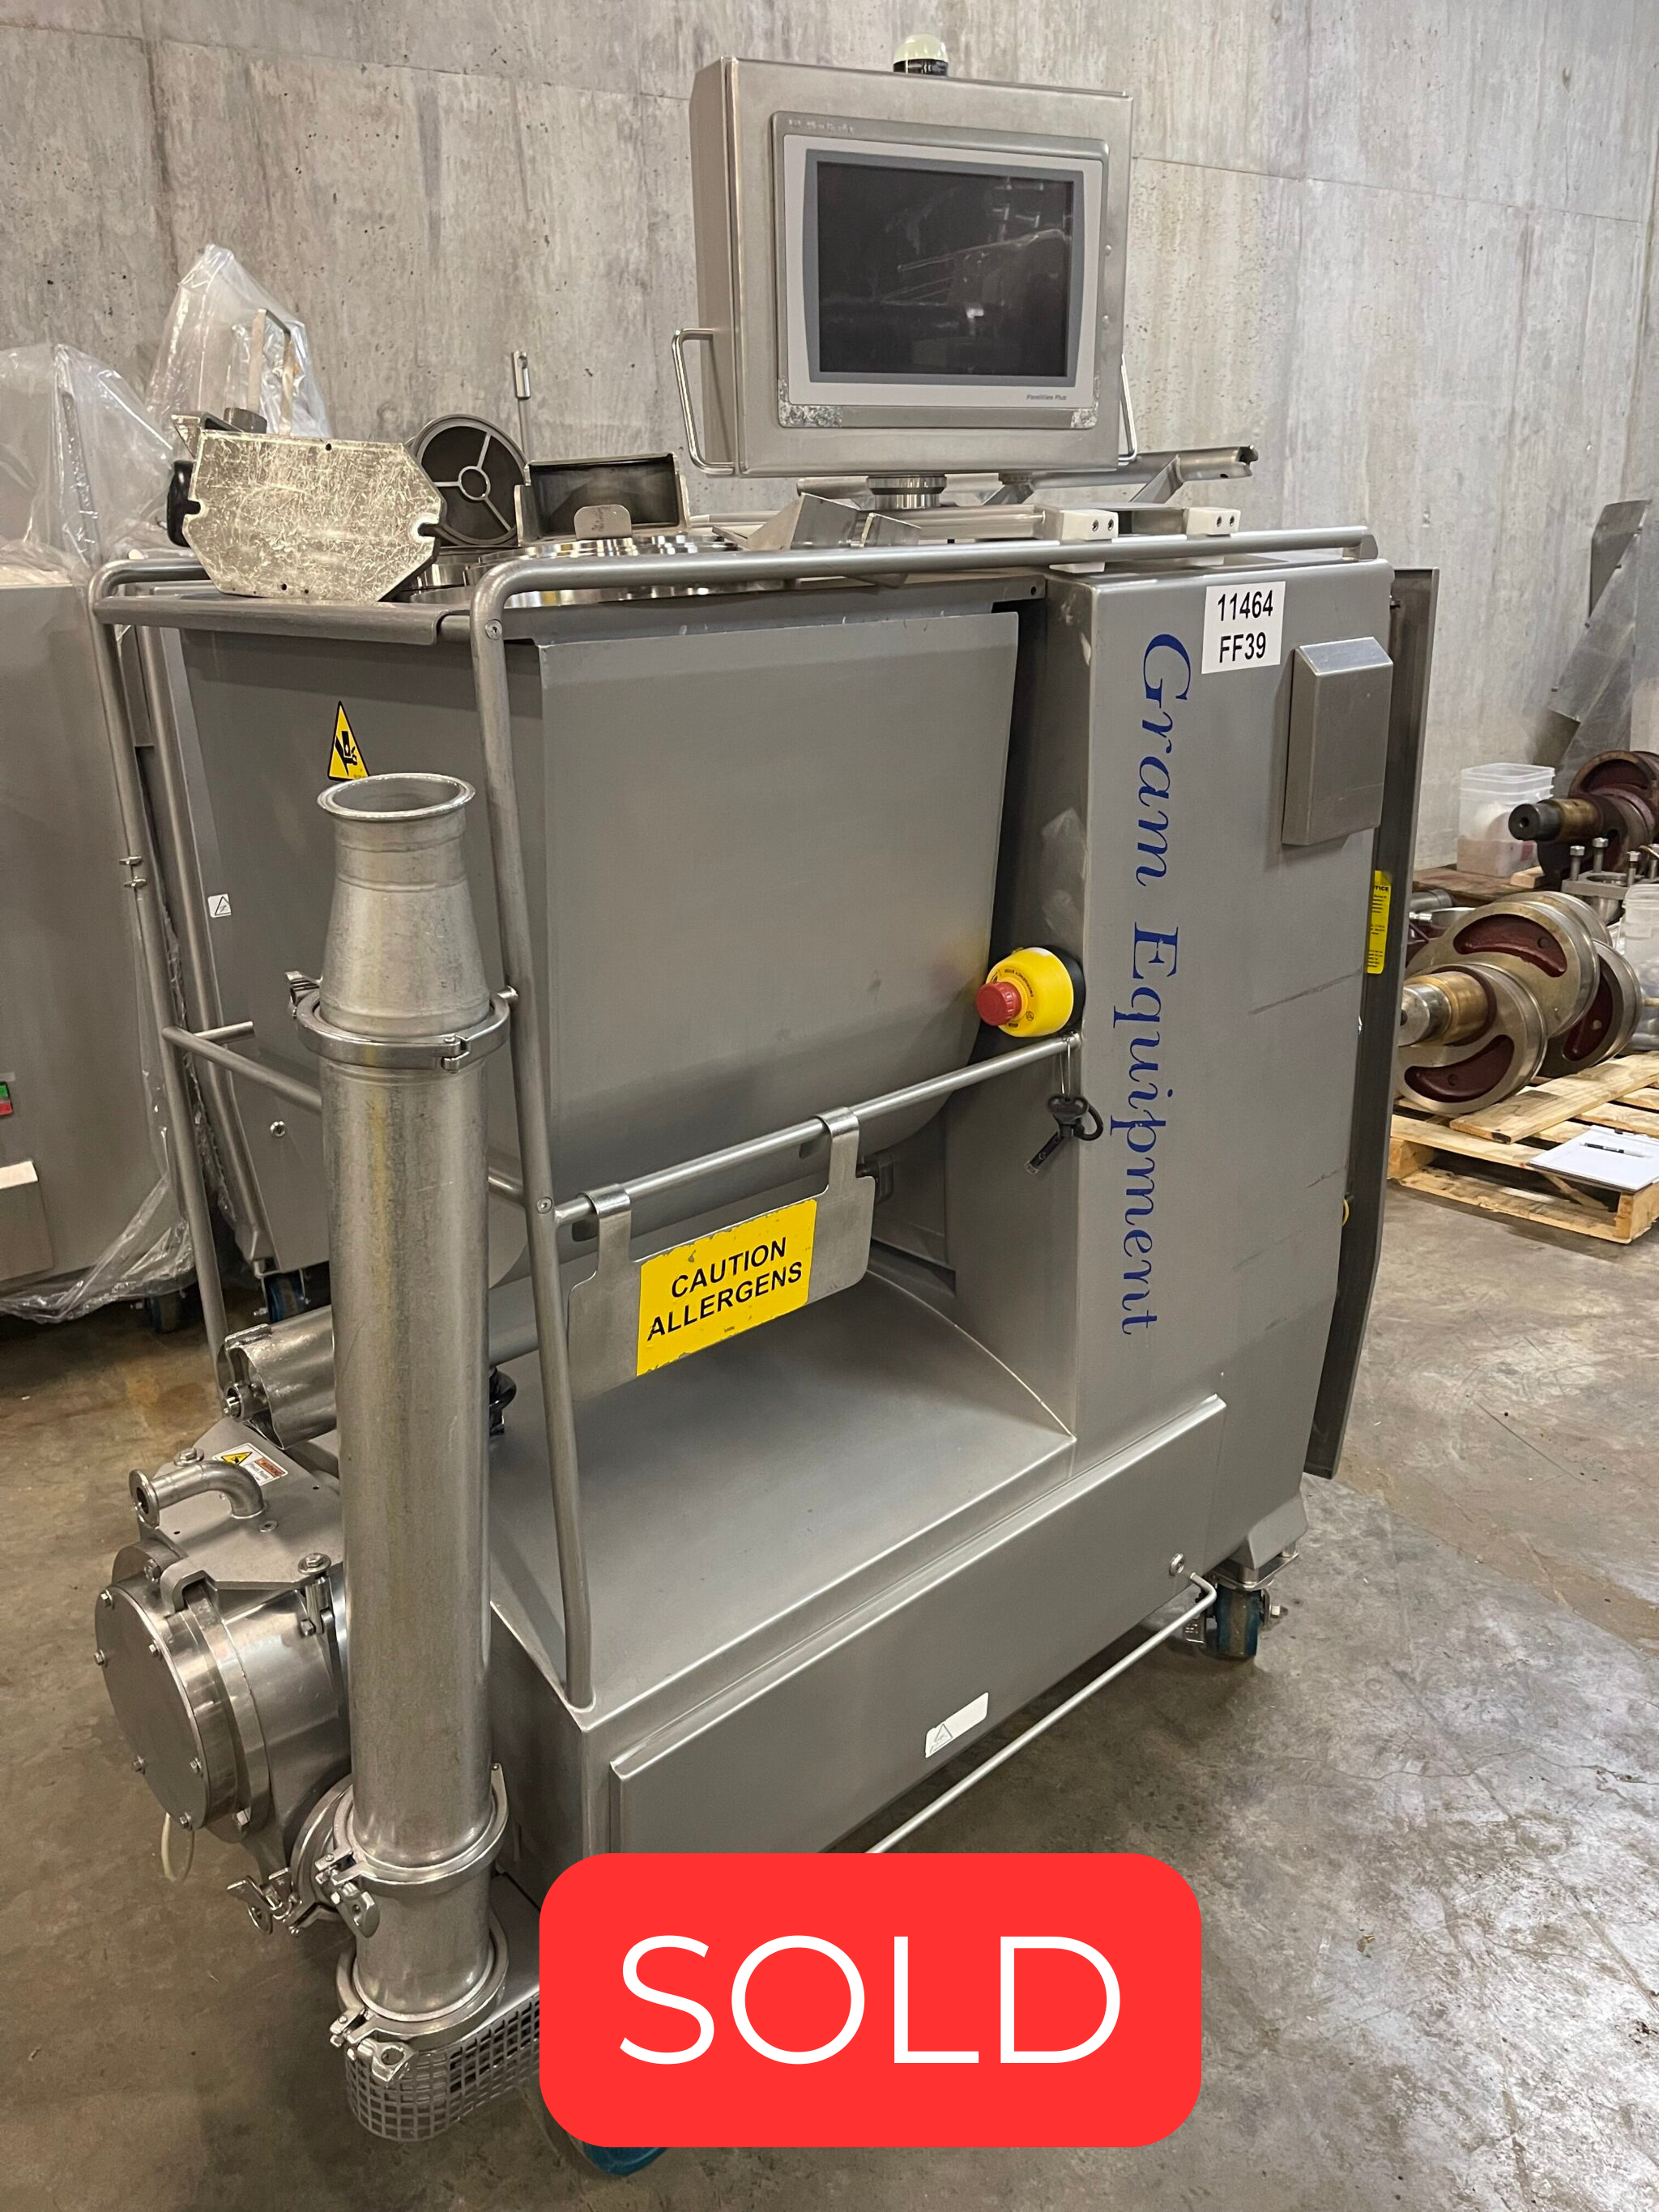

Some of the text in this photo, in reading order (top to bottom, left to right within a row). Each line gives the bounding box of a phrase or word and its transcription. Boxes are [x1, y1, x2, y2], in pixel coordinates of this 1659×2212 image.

[1218, 590, 1273, 621] 11464
[1219, 632, 1266, 663] FF39
[1111, 633, 1192, 1336] Gram Equipment
[671, 1236, 787, 1298] CAUTION
[646, 1261, 803, 1342] ALLERGENS
